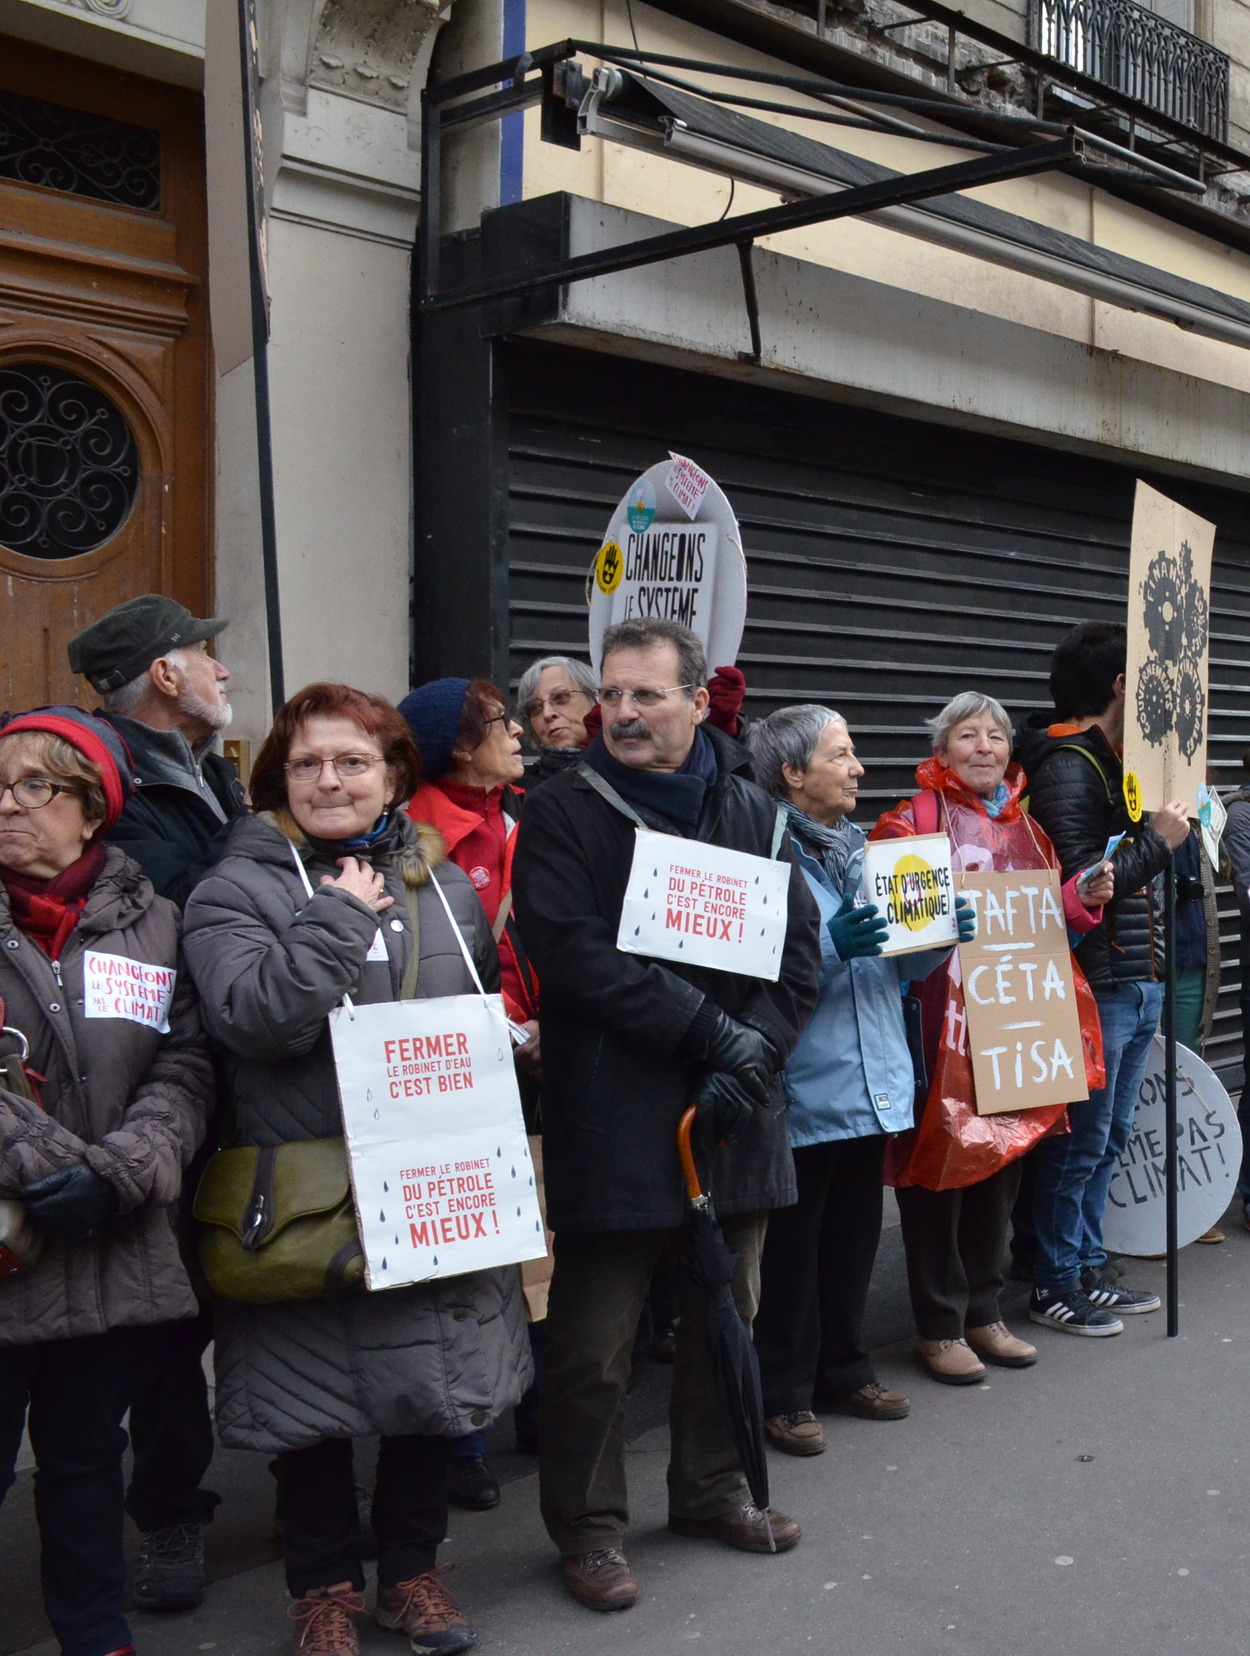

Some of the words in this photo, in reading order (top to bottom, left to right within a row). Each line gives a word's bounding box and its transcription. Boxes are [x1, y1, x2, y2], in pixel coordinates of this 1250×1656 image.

[625, 533, 706, 582] CHANGEONS
[669, 864, 701, 878] FERMER
[704, 872, 713, 881] LE
[717, 875, 748, 888] ROBINET
[901, 867, 950, 894] D'URGENCE
[668, 877, 685, 892] DU
[690, 880, 747, 905] PÉTROLE
[667, 893, 698, 910] C'EST
[704, 901, 746, 920] ENCORE
[957, 885, 1064, 935] TAFTA
[665, 908, 732, 941] MIEUX
[89, 957, 173, 993] CHANGEONS
[967, 954, 1066, 1005] CÉTA
[92, 980, 101, 990] LE
[105, 978, 165, 1005] SYSTEME
[98, 1004, 108, 1012] LE
[114, 998, 160, 1022] CLIMAT
[384, 1033, 469, 1064] FERMER
[387, 1066, 399, 1077] LE
[402, 1060, 442, 1076] ROBINET
[445, 1057, 471, 1070] D'EAU
[389, 1077, 432, 1099] C'EST
[438, 1072, 473, 1092] BIEN
[400, 1166, 436, 1180] FERMER
[440, 1164, 451, 1174] LE
[455, 1158, 489, 1172] ROBINET
[403, 1183, 422, 1202] DU
[427, 1173, 494, 1198] PÉTROLE
[405, 1201, 440, 1219] C'EST
[448, 1192, 496, 1213] ENCORE
[409, 1212, 487, 1248] MIEUX
